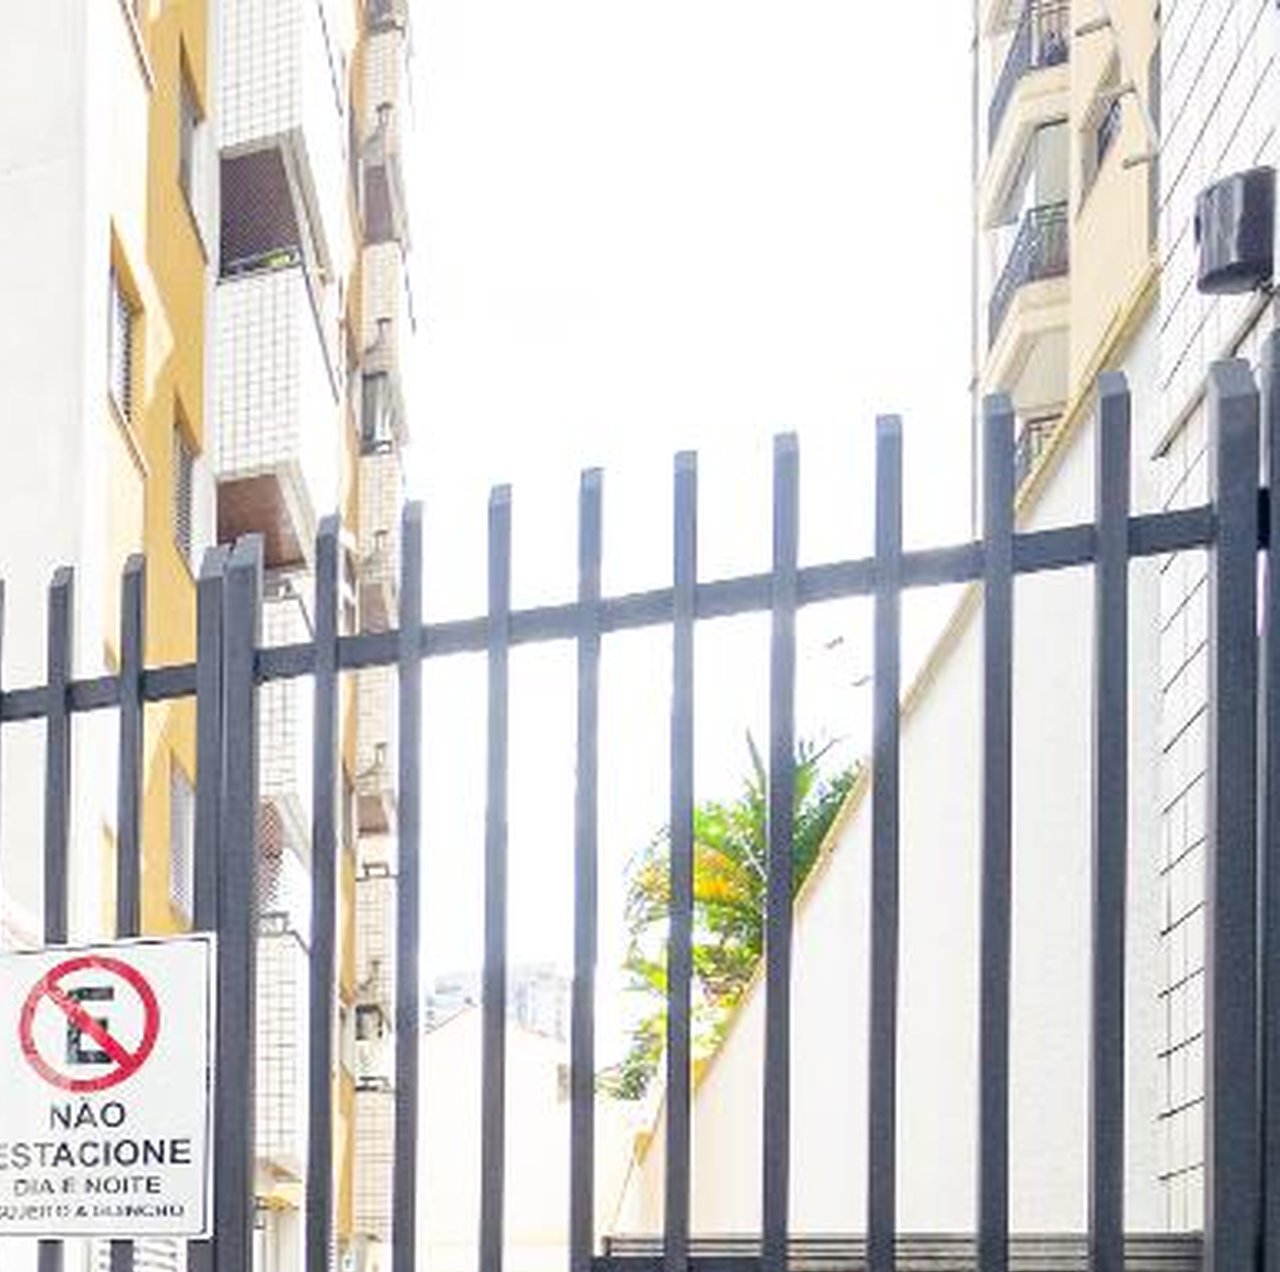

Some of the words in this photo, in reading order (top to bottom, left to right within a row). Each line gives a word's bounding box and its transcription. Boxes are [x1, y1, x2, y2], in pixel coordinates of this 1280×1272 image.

[49, 1096, 127, 1130] NÃO
[14, 1178, 55, 1196] DIA
[86, 1175, 162, 1194] NOITE
